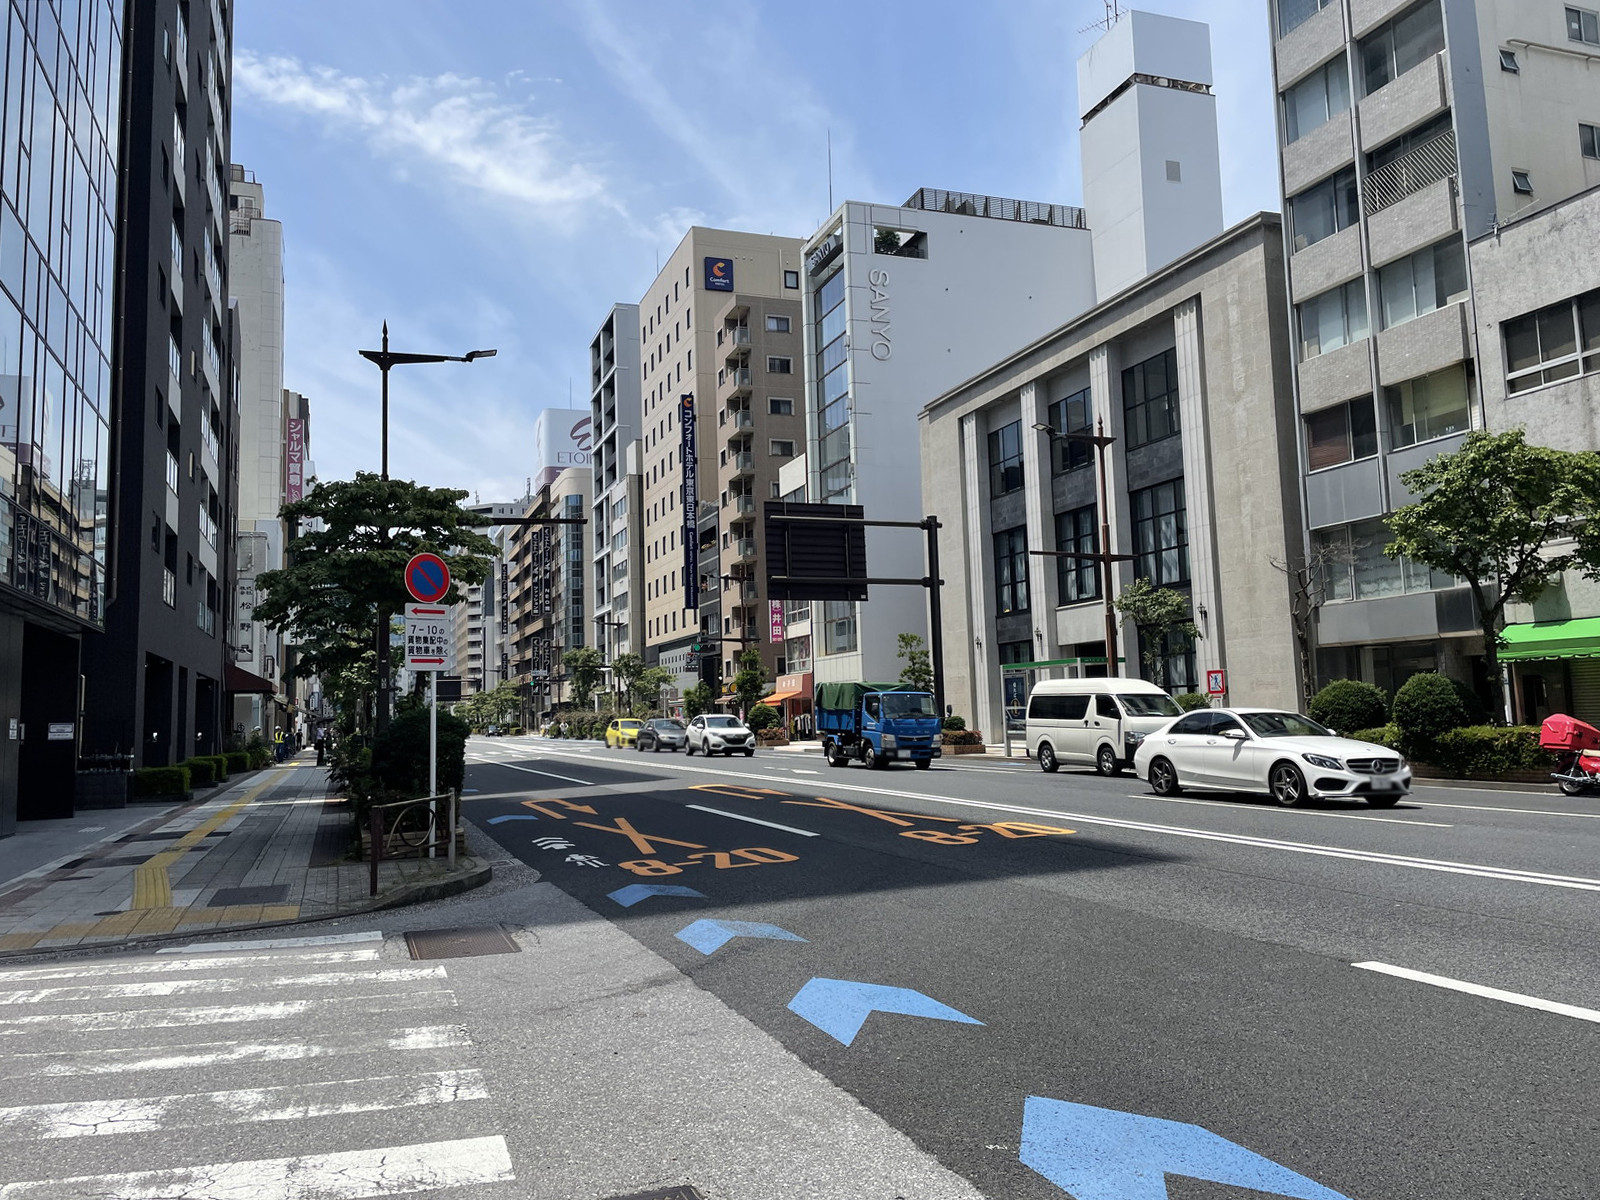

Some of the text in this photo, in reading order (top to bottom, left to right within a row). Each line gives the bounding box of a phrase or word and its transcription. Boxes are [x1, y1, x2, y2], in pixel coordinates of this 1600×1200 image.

[868, 268, 892, 361] SANYO
[288, 421, 302, 487] シャルマ貿易
[407, 635, 448, 645] 貨物集配中の
[407, 645, 448, 655] 貨物車を除く
[898, 821, 1078, 845] 8-20
[617, 847, 800, 877] 8-20
